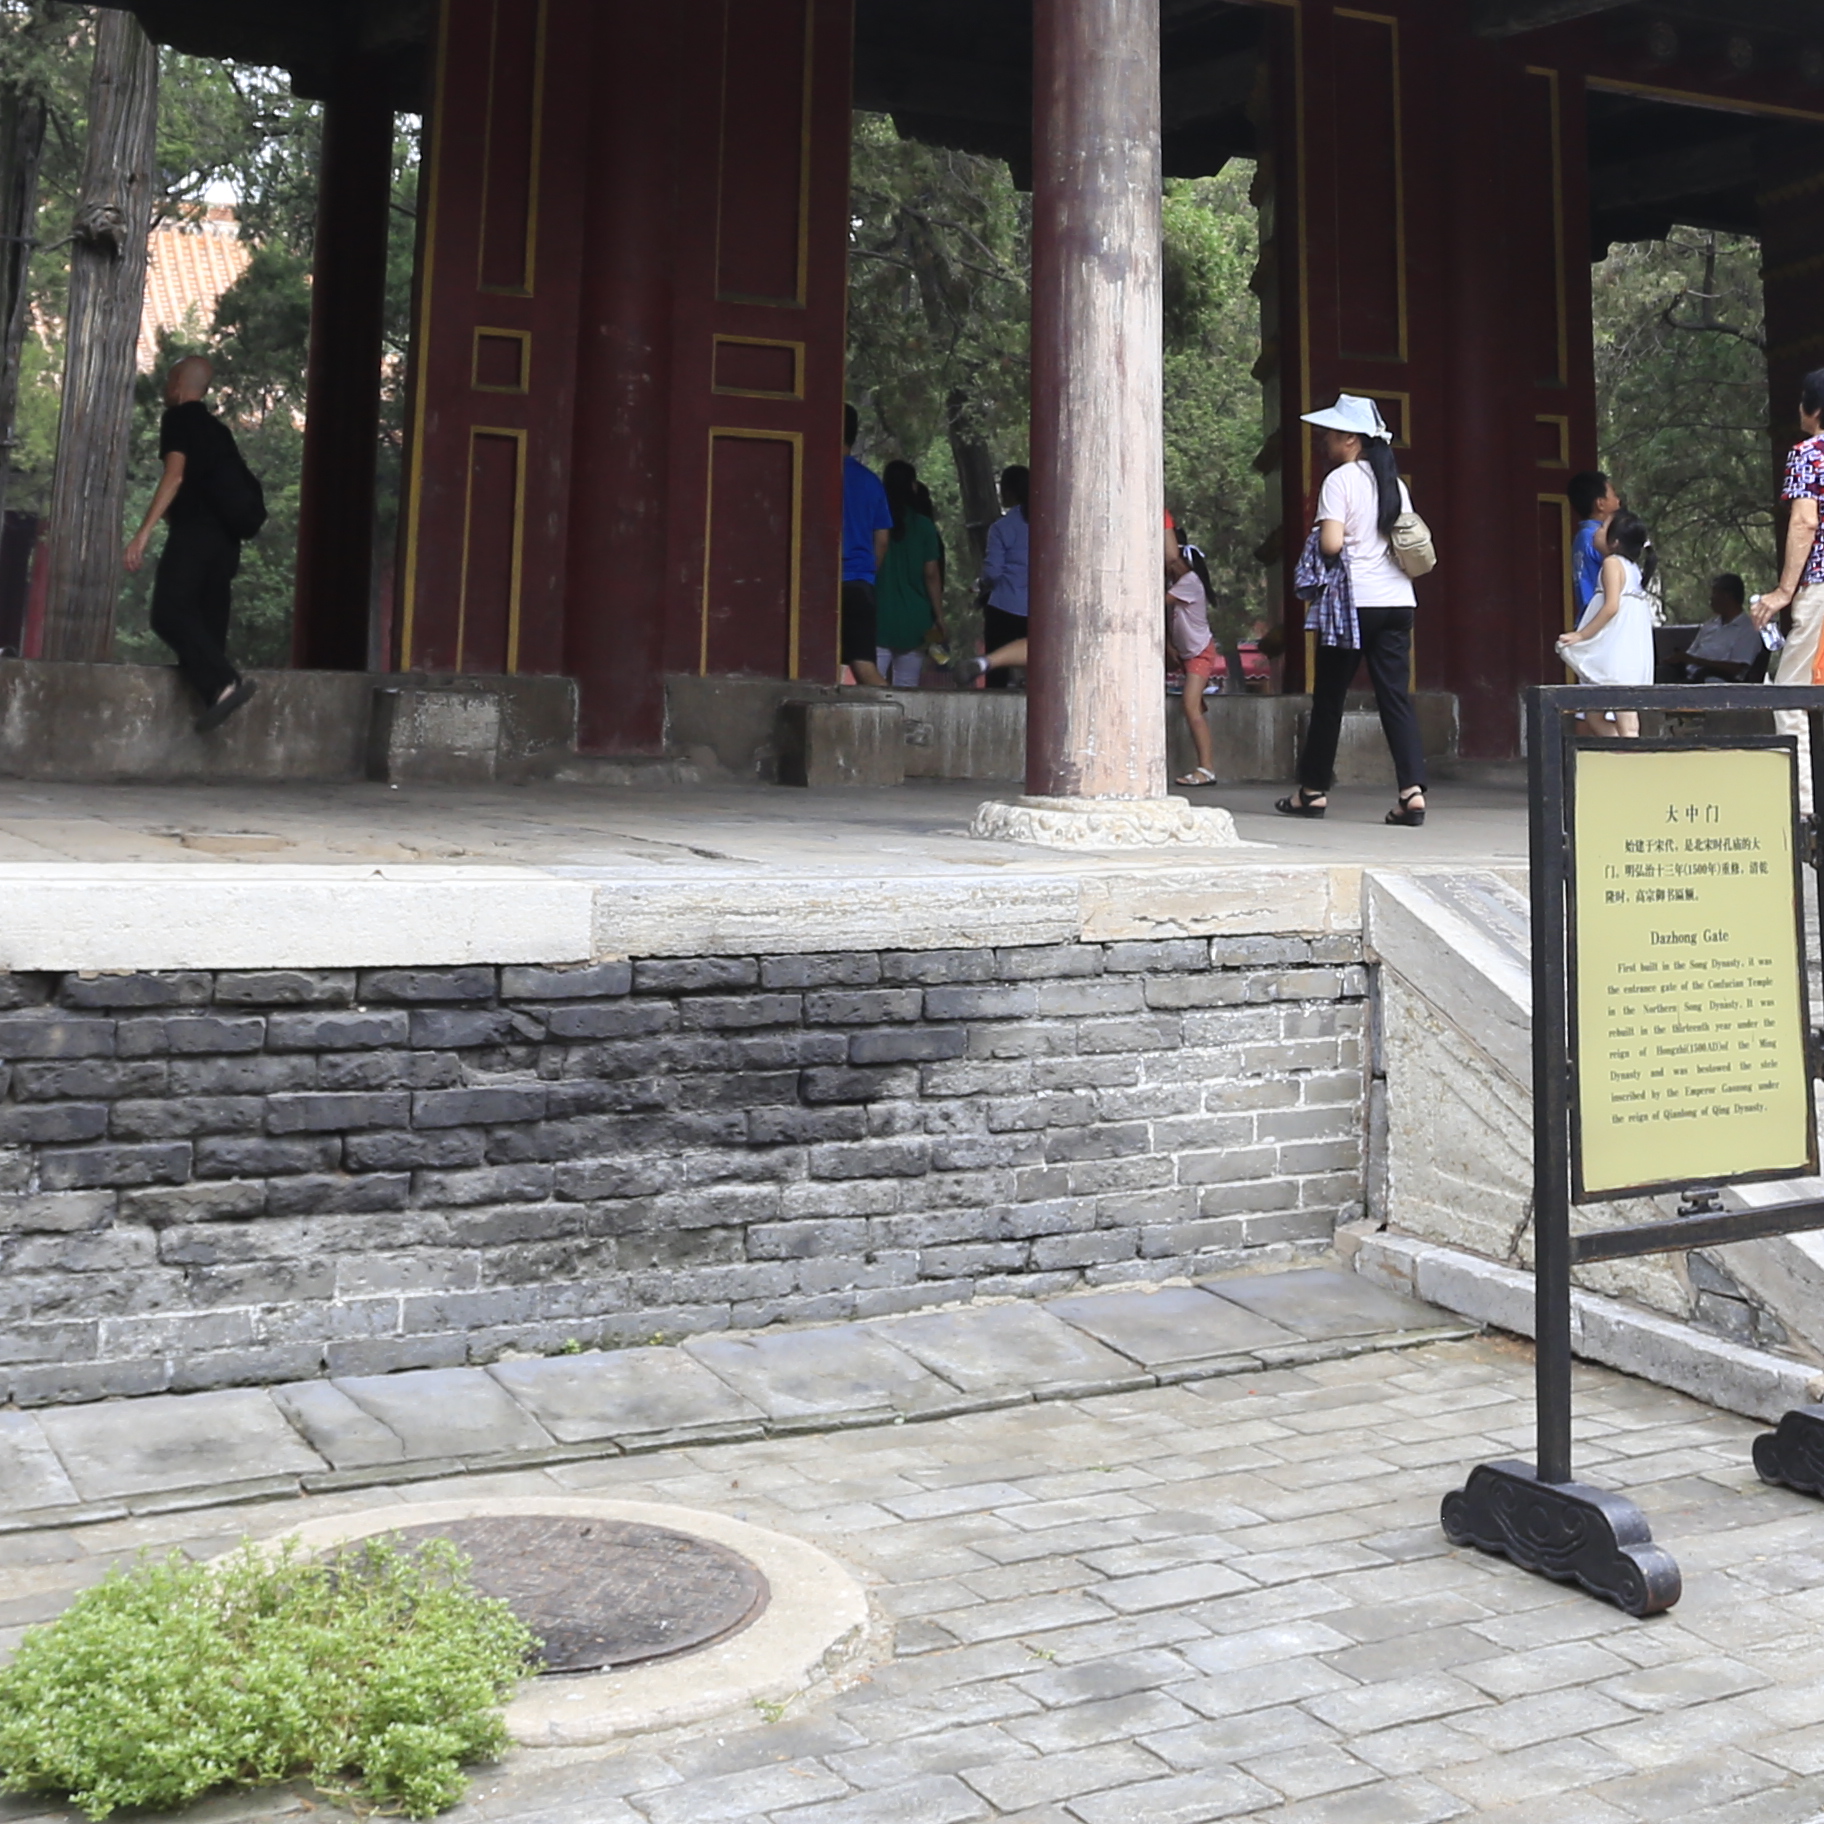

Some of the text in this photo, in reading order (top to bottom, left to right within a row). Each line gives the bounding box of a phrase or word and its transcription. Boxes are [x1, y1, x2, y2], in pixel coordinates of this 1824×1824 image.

[1665, 804, 1720, 824] 大中门
[1651, 928, 1729, 946] Dazhong Gate
[1618, 962, 1636, 973] First
[1640, 961, 1658, 972] built
[1662, 961, 1670, 970] in
[1674, 961, 1686, 970] the
[1689, 959, 1708, 970] Song
[1748, 957, 1754, 966] it
[1607, 976, 1773, 994] the entrance gate of the Confucian Temple
[1608, 1006, 1616, 1016] in
[1623, 1005, 1635, 1015] the
[1643, 1003, 1677, 1014] Northern
[1684, 1001, 1702, 1012] Song
[1746, 998, 1753, 1008] It
[1608, 1018, 1775, 1038] rebuilt in the thirteenth year under the
[1609, 1049, 1630, 1059] reign
[1639, 1047, 1647, 1056] of
[1738, 1040, 1750, 1049] the
[1759, 1038, 1776, 1049] Ming
[1610, 1069, 1641, 1081] Dynasty
[1650, 1067, 1664, 1077] and
[1697, 1062, 1731, 1073] bestowed
[1740, 1061, 1752, 1070] the
[1760, 1059, 1778, 1068] stele
[1611, 1090, 1646, 1102] inscribed
[1651, 1089, 1660, 1100] by
[1667, 1088, 1679, 1097] the
[1685, 1086, 1716, 1097] Emperor
[1758, 1080, 1779, 1090] under
[1612, 1114, 1624, 1124] the
[1628, 1112, 1648, 1122] reign
[1652, 1110, 1660, 1120] of
[1663, 1108, 1697, 1121] Qianlong
[1701, 1106, 1709, 1116] of
[1712, 1105, 1730, 1116] Qing
